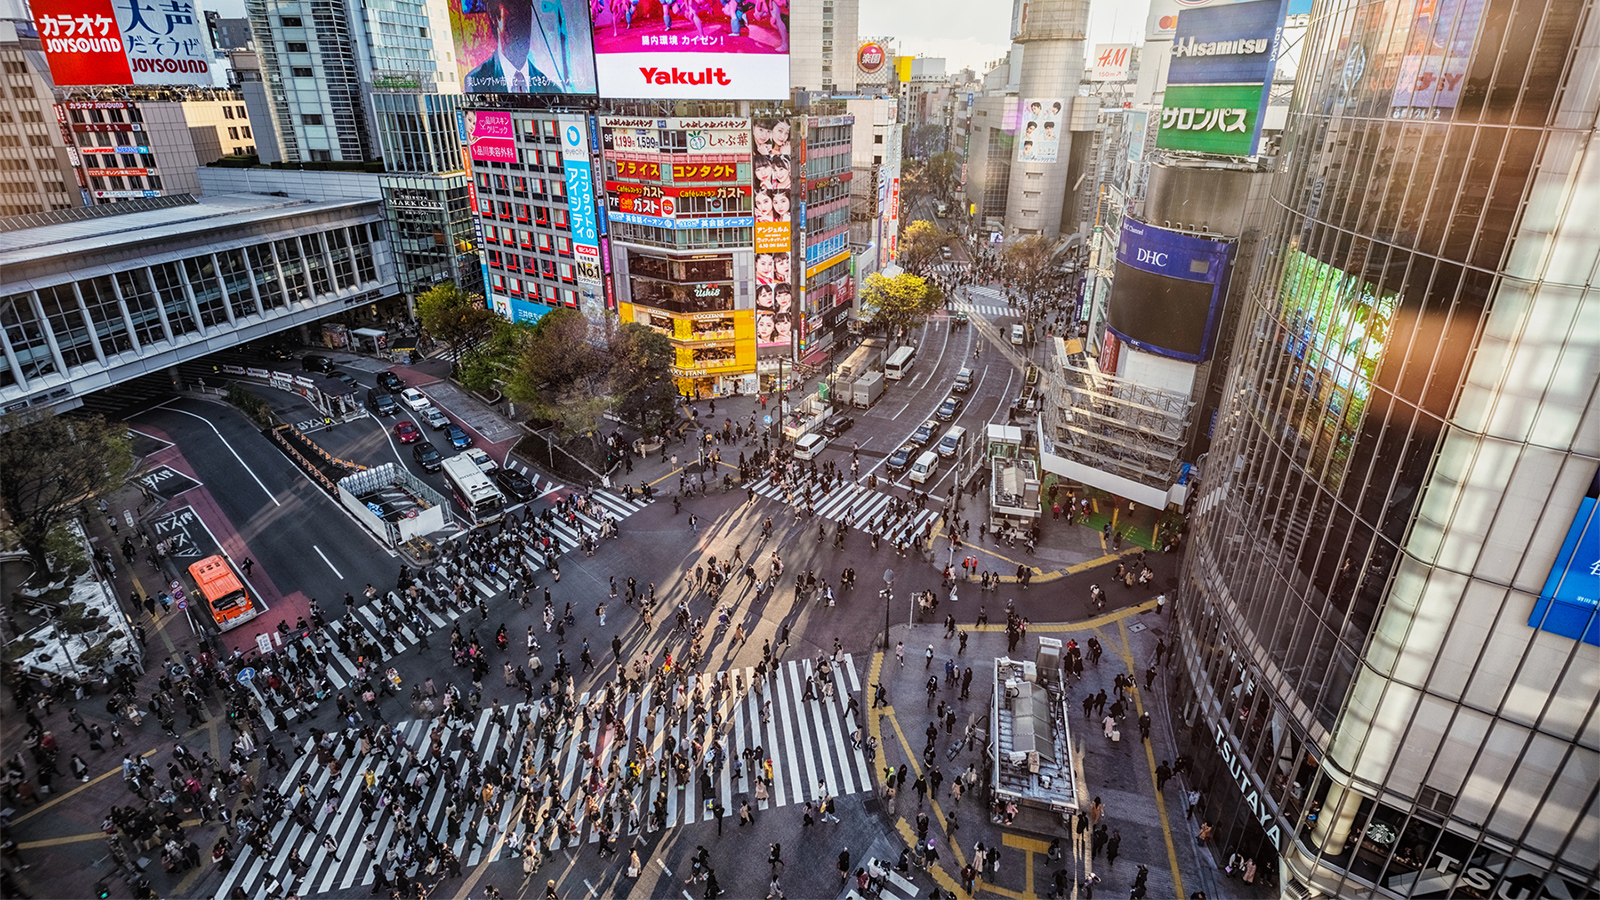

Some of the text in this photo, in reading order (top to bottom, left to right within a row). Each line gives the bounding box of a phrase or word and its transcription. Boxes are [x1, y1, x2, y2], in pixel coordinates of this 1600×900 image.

[40, 13, 113, 37] カラオケ
[117, 0, 199, 35] 大声
[46, 37, 121, 54] JOYSOUND
[1171, 37, 1269, 58] Hisamitsu
[131, 58, 208, 74] JOYSOUND
[1097, 48, 1128, 67] H&M
[638, 67, 732, 87] Yakult
[679, 120, 747, 128] しゃぶしゃぶバイキング
[1162, 108, 1247, 133] サロンパス
[604, 134, 613, 142] 9F
[709, 132, 749, 147] しゃぶ葉
[617, 162, 735, 178] プライス コンタクト
[643, 185, 665, 198] ガスト
[717, 187, 746, 199] ガスト
[567, 167, 584, 239] アイシティ
[579, 169, 596, 240] コンタクトの
[633, 198, 660, 214] ガスト
[626, 215, 663, 227] 英会話イーオン
[701, 220, 752, 230] 英会話イーオン
[1136, 248, 1168, 267] DHC
[576, 260, 602, 280] No.1
[1215, 724, 1281, 851] TSUTAYA
